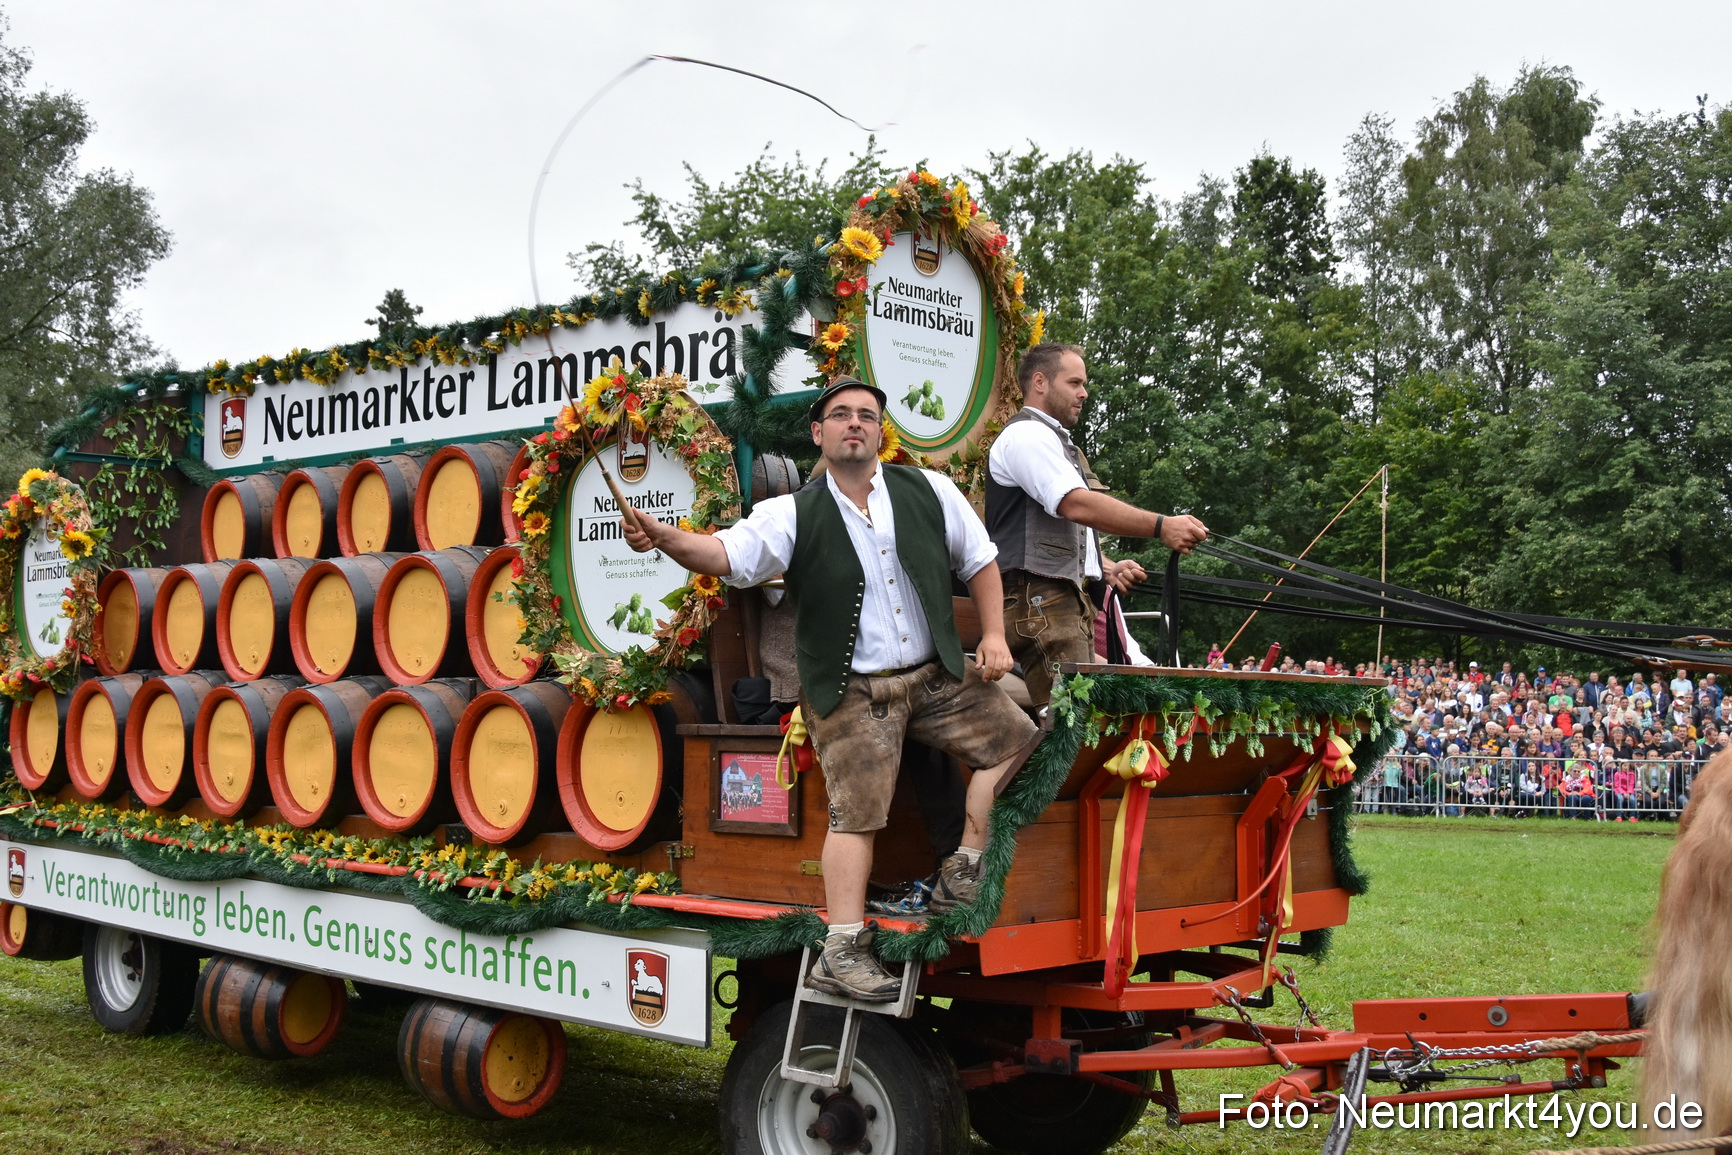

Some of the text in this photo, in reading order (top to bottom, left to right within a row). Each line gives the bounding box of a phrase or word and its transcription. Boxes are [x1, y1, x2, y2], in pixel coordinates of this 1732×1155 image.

[919, 261, 934, 272] 1628
[888, 276, 963, 309] Neumarkter
[872, 297, 974, 338] Lammsbräu
[892, 338, 956, 359] Verantwortung leben.
[898, 352, 949, 369] Genuss schaffen.
[262, 310, 754, 446] Neumarkter Lammsbrä
[625, 468, 641, 478] 1628
[605, 568, 659, 580] Genuss schaffen.
[41, 858, 591, 1000] Verantwortung leben. Genuss schaffen.
[637, 1006, 657, 1021] 1628
